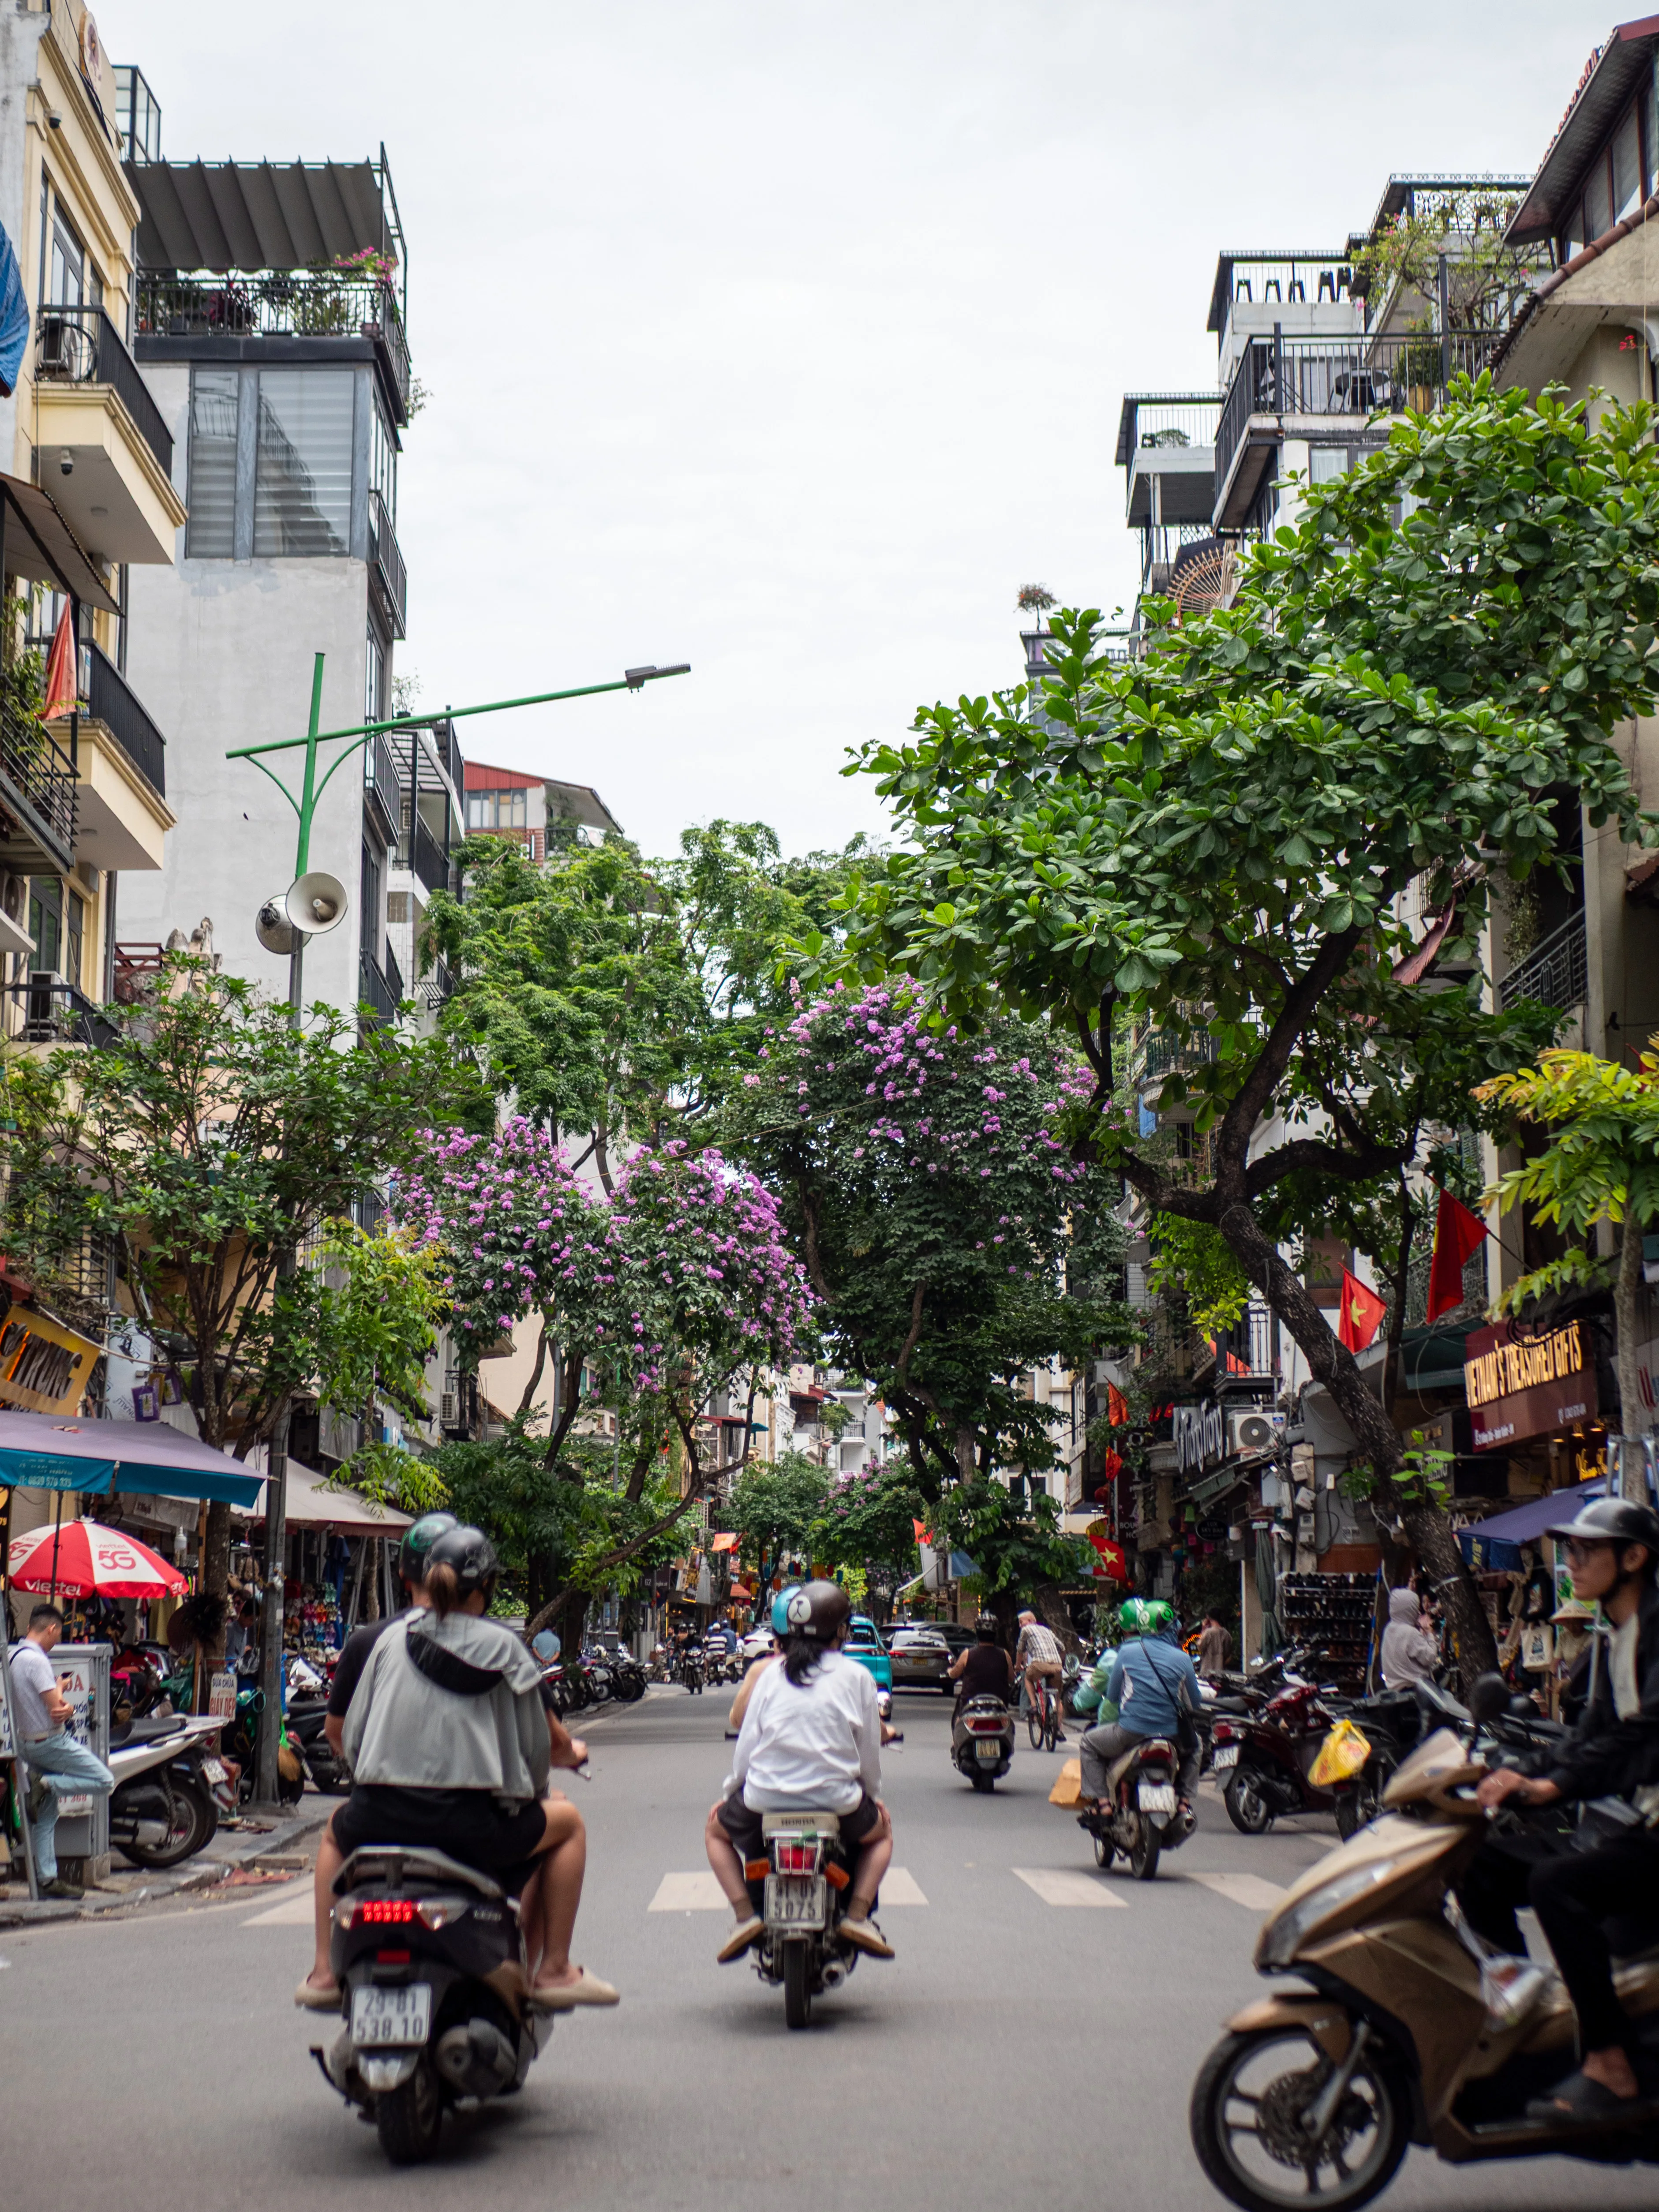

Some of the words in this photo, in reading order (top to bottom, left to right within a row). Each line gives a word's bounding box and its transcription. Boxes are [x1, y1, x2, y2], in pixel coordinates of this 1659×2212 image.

[1553, 1320, 1582, 1378] GIFTS
[98, 1550, 136, 1570] 5G
[781, 1817, 815, 1826] HONDA
